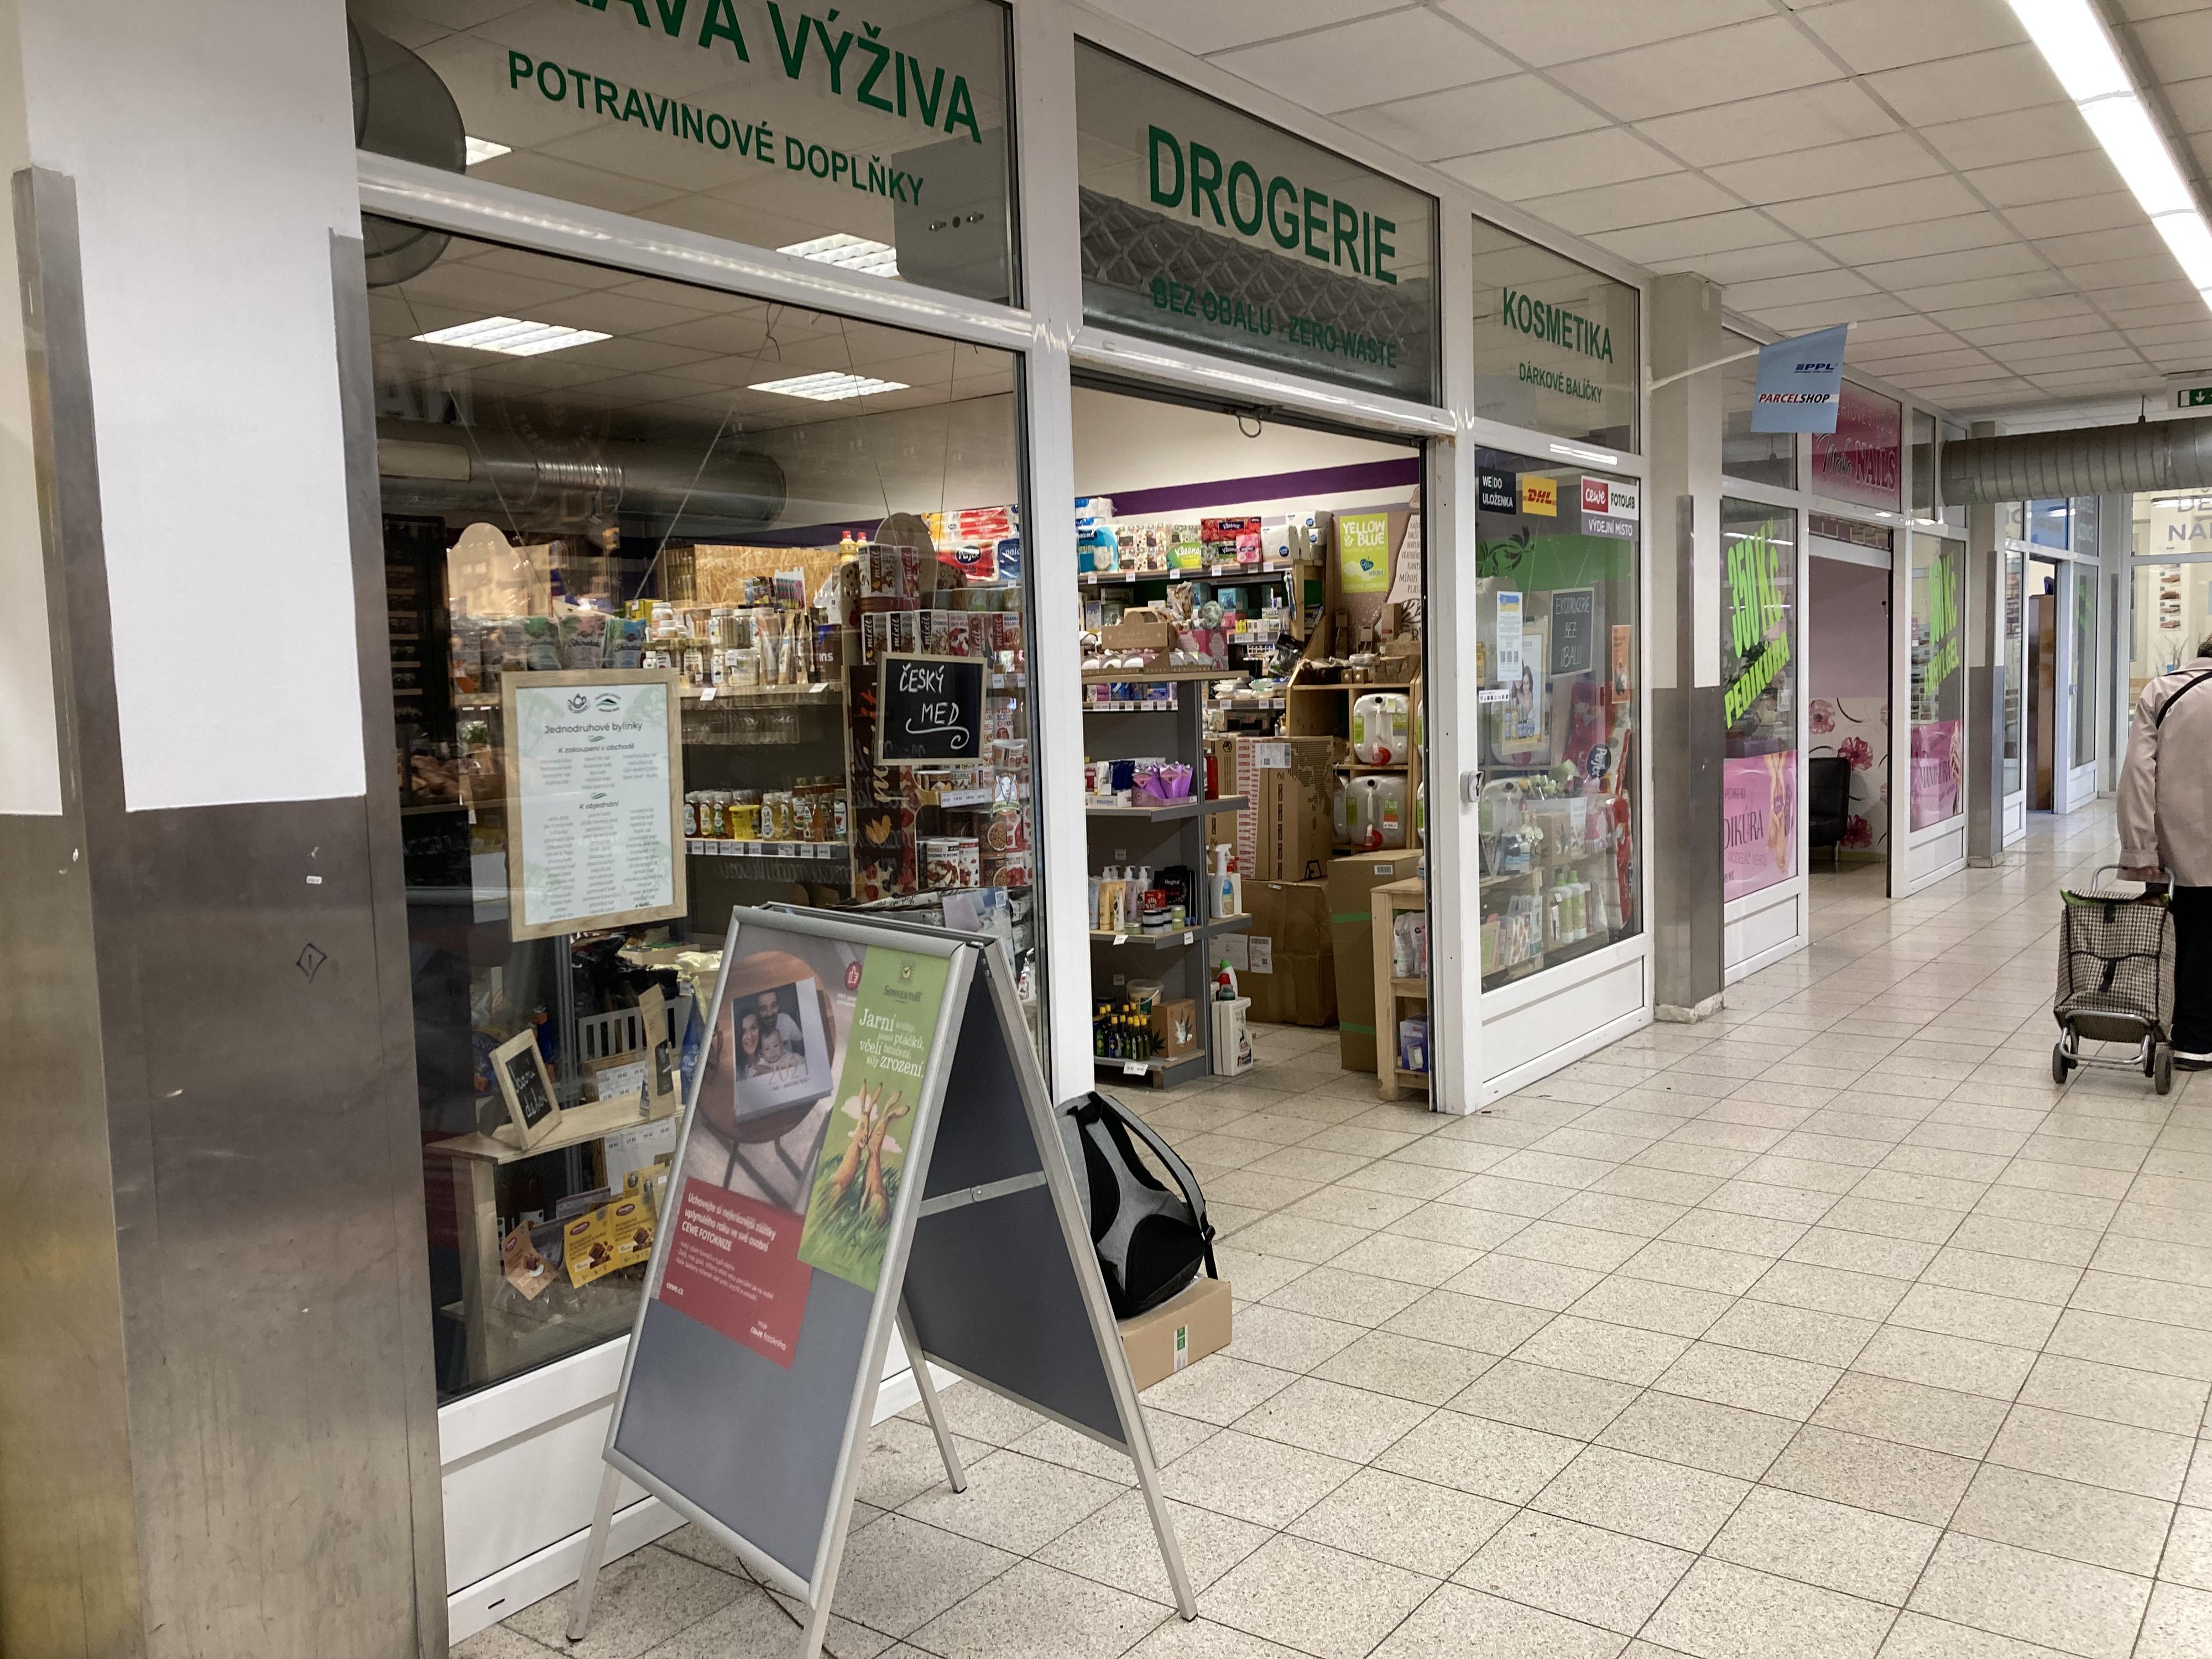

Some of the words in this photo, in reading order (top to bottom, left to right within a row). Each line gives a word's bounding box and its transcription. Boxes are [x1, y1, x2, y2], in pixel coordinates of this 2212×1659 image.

[767, 1, 982, 144] VÝŽIVA
[508, 50, 775, 164] POTRAVINOVÉ
[785, 136, 924, 206] DOPLŇKY
[1148, 124, 1397, 285] DROGERIE
[1152, 276, 1197, 317] BEZ
[1201, 291, 1272, 336] OBALU
[1288, 315, 1337, 353] ZERO
[1340, 330, 1397, 369] WASTE
[1503, 287, 1613, 363] KOSMETIKA
[1519, 361, 1564, 393] DÁRKOVÉ
[1566, 378, 1603, 403] BALÍČKY
[1759, 393, 1830, 403] PARCELSHOP
[1855, 440, 1896, 491] NAILS
[1483, 493, 1514, 508] ULOŽENKA
[1527, 488, 1552, 504] DHL
[1611, 492, 1635, 509] FOTOLAB
[1343, 520, 1385, 535] YELLOW
[1589, 517, 1614, 534] VÝDEJNÍ
[1615, 519, 1633, 536] MÍSTO
[1344, 535, 1354, 547] &
[1358, 531, 1385, 547] BLUE
[1728, 535, 1760, 659] 350
[891, 616, 900, 646] mixit
[899, 662, 945, 694] ČESKÝ
[921, 702, 959, 726] MED
[544, 723, 610, 734] Jednodruhové
[612, 722, 643, 732] bylinky
[585, 801, 619, 810] objednání
[1724, 805, 1764, 849] DIKÚRA
[859, 1009, 896, 1032] Jarní
[860, 1039, 884, 1055] včelí
[893, 1034, 924, 1051] ptáčků,
[880, 1056, 924, 1078] zrození.
[682, 1221, 700, 1237] CEWE
[699, 1228, 733, 1251] FOTOKNIZE
